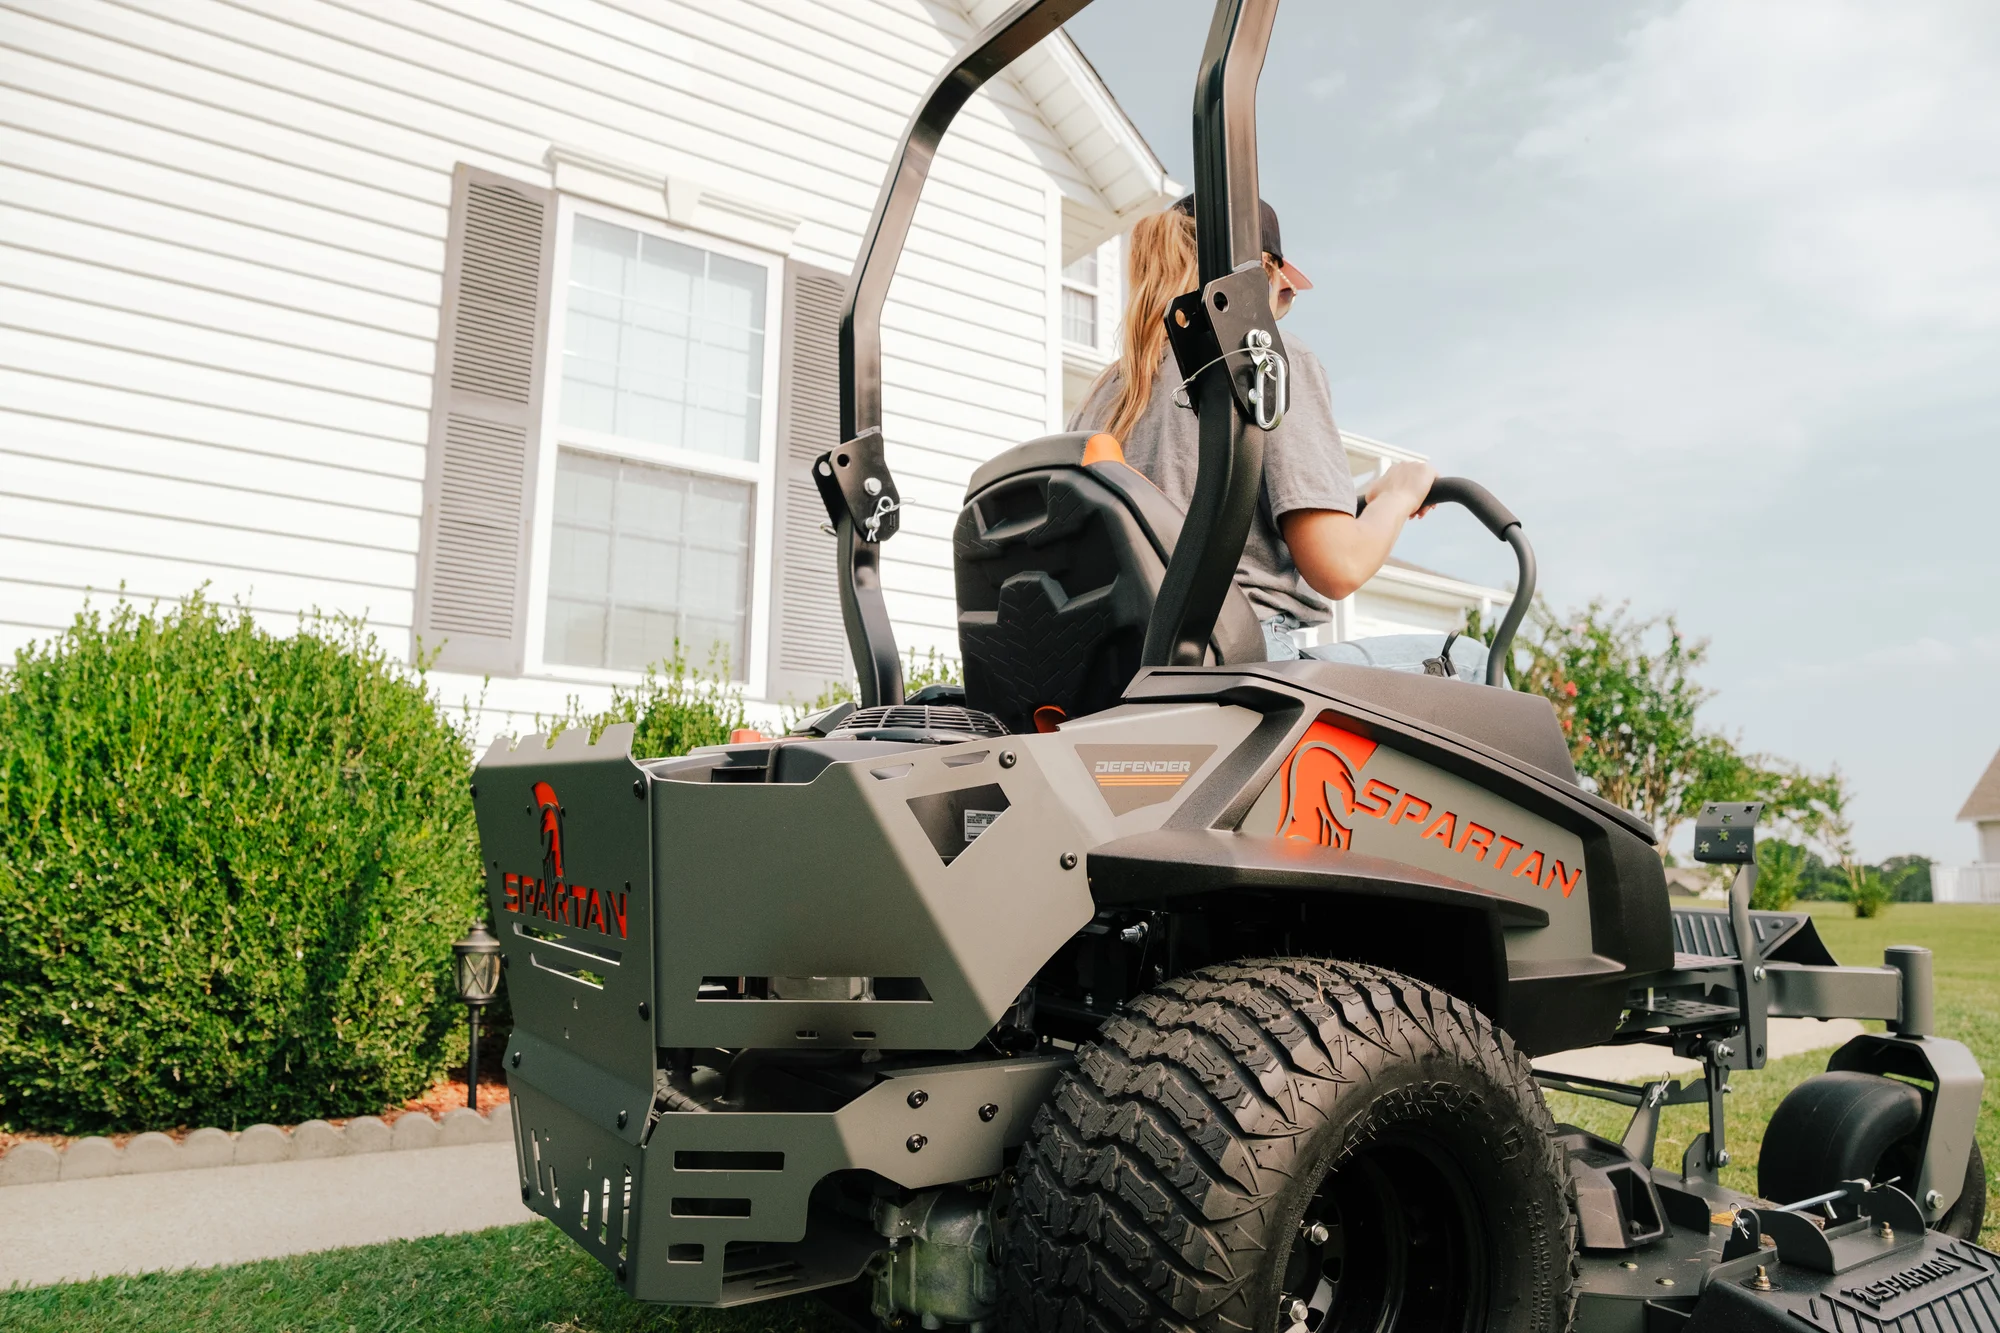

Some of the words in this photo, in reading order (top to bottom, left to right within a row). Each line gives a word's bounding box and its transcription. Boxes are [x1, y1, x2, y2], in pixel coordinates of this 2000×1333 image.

[1094, 761, 1191, 772] DEFENDER
[1354, 778, 1582, 898] SPARTAN
[503, 872, 628, 940] SPARTAN
[1865, 1257, 1961, 1300] SPARTAN
